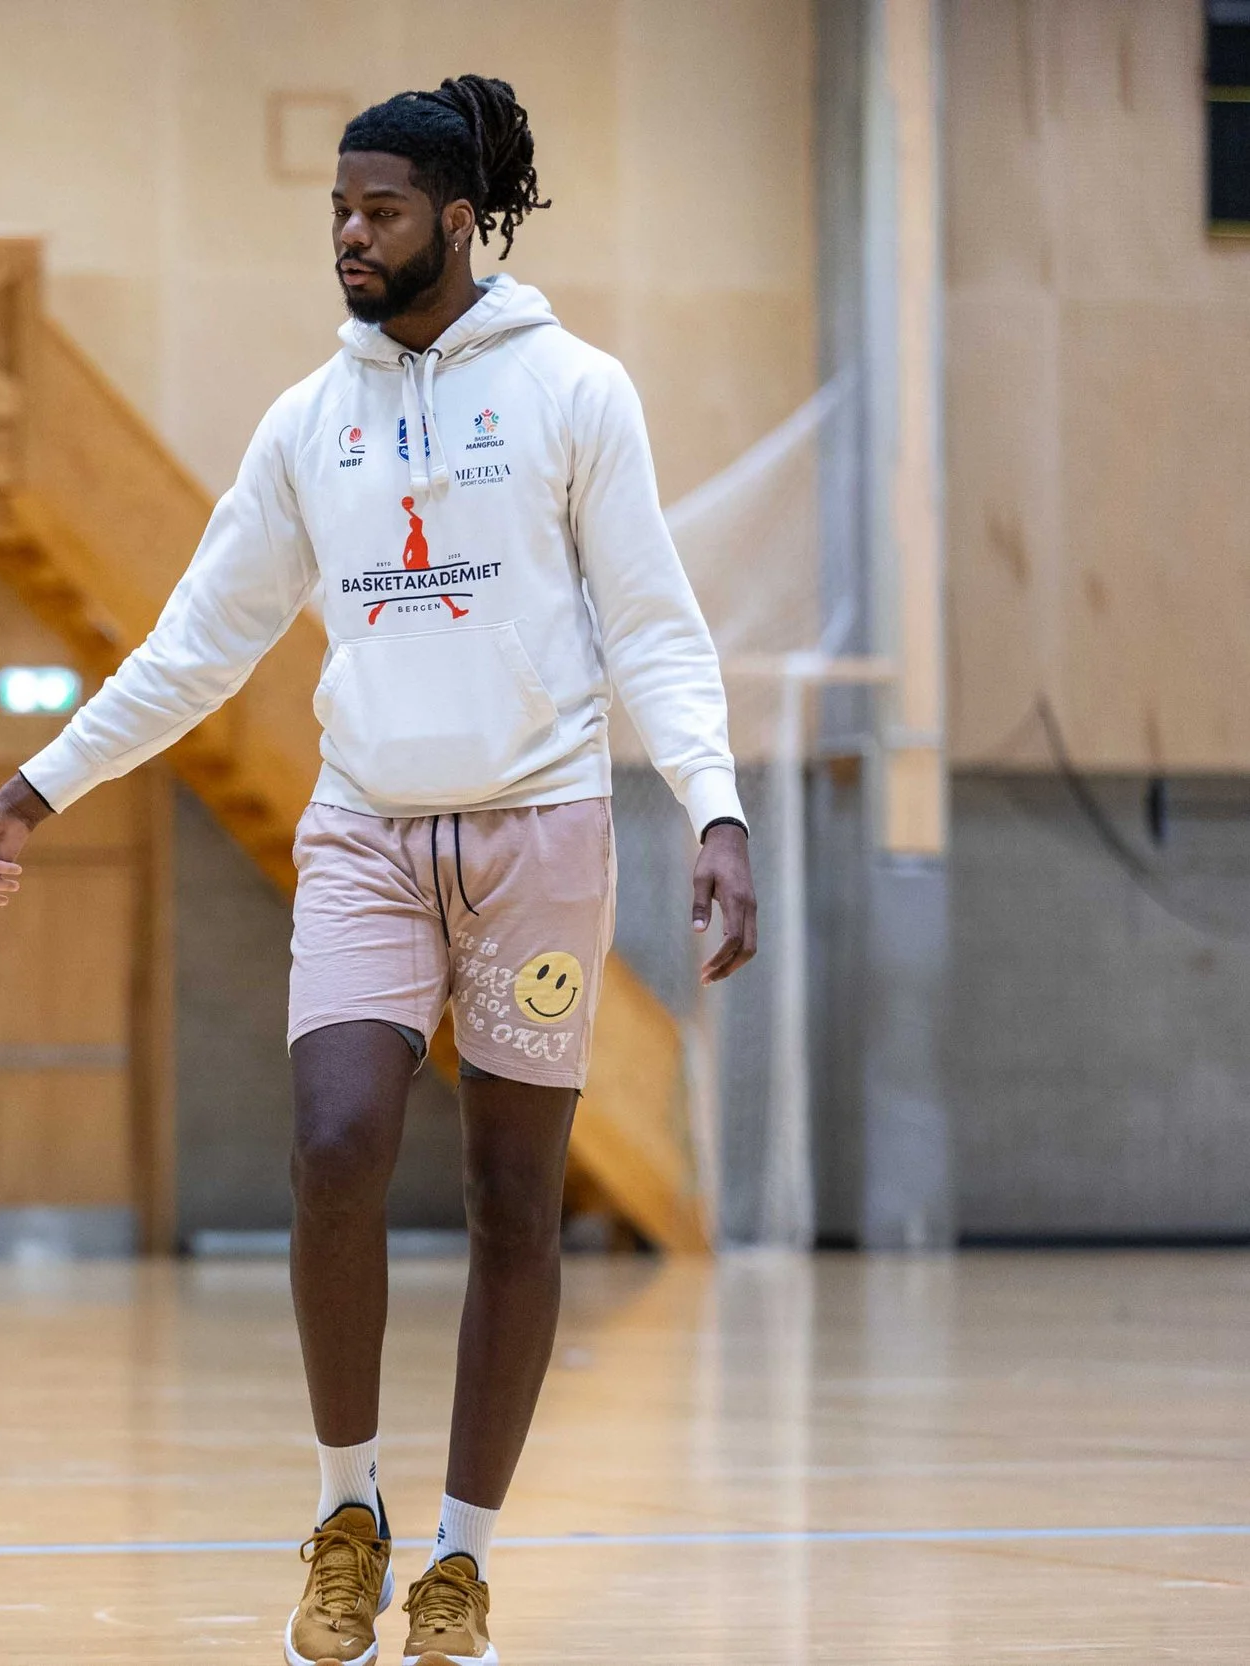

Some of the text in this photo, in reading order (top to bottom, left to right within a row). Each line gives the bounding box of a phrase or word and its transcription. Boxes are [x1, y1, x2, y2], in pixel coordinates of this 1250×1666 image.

[466, 440, 504, 450] MANGFOLD
[339, 457, 363, 468] NBBF
[455, 464, 511, 481] METEVA
[460, 479, 477, 487] SPORT
[487, 476, 504, 484] HELSE
[342, 562, 501, 593] BASKETAKADEMIET
[397, 603, 441, 613] BERGEN
[479, 937, 499, 957] is
[475, 992, 510, 1019] not
[491, 1023, 575, 1062] OKAY
